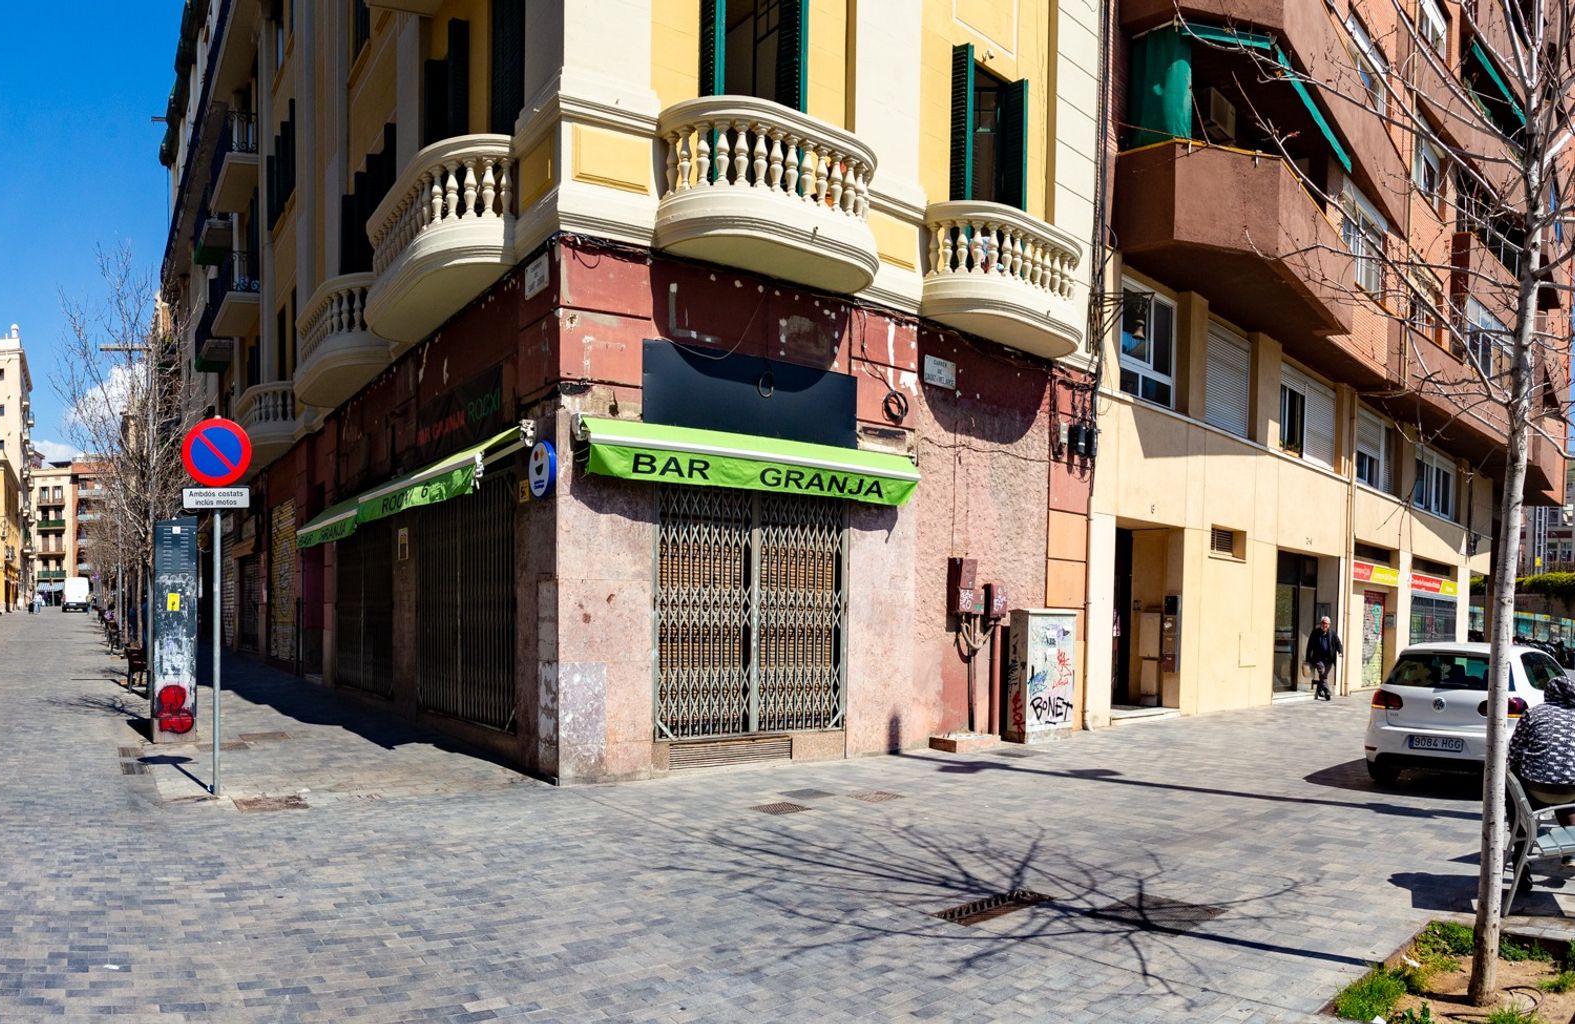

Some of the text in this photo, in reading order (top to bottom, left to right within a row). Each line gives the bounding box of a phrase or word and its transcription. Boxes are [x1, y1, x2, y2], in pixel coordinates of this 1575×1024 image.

[631, 453, 884, 499] BAR GRANJA
[420, 482, 430, 498] 6
[1030, 696, 1073, 721] BONET
[1414, 737, 1461, 749] 9084 HGG
